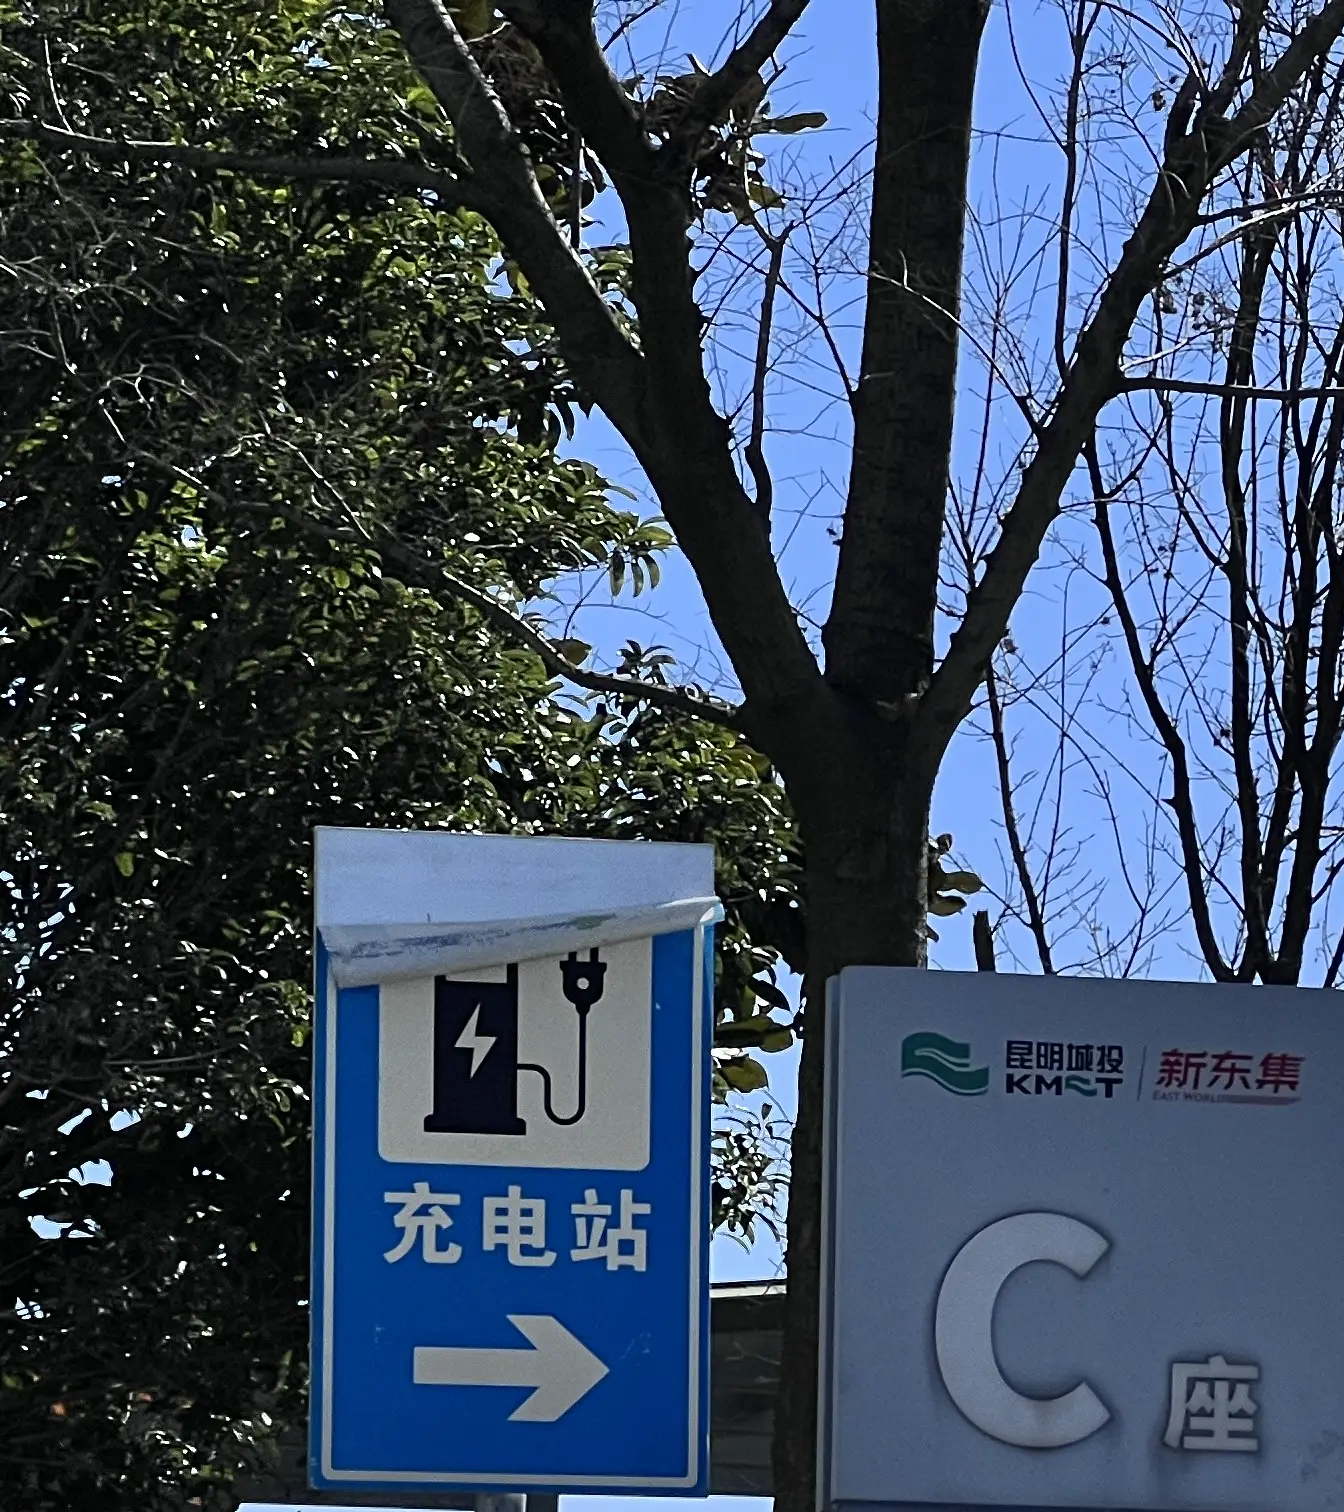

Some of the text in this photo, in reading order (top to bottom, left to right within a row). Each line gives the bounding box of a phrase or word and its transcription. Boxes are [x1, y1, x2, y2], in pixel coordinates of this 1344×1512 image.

[1006, 1040, 1124, 1074] 昆明城投
[1155, 1047, 1306, 1093] 新东集
[382, 1181, 652, 1273] 充电站
[935, 1211, 1262, 1453] C 座
